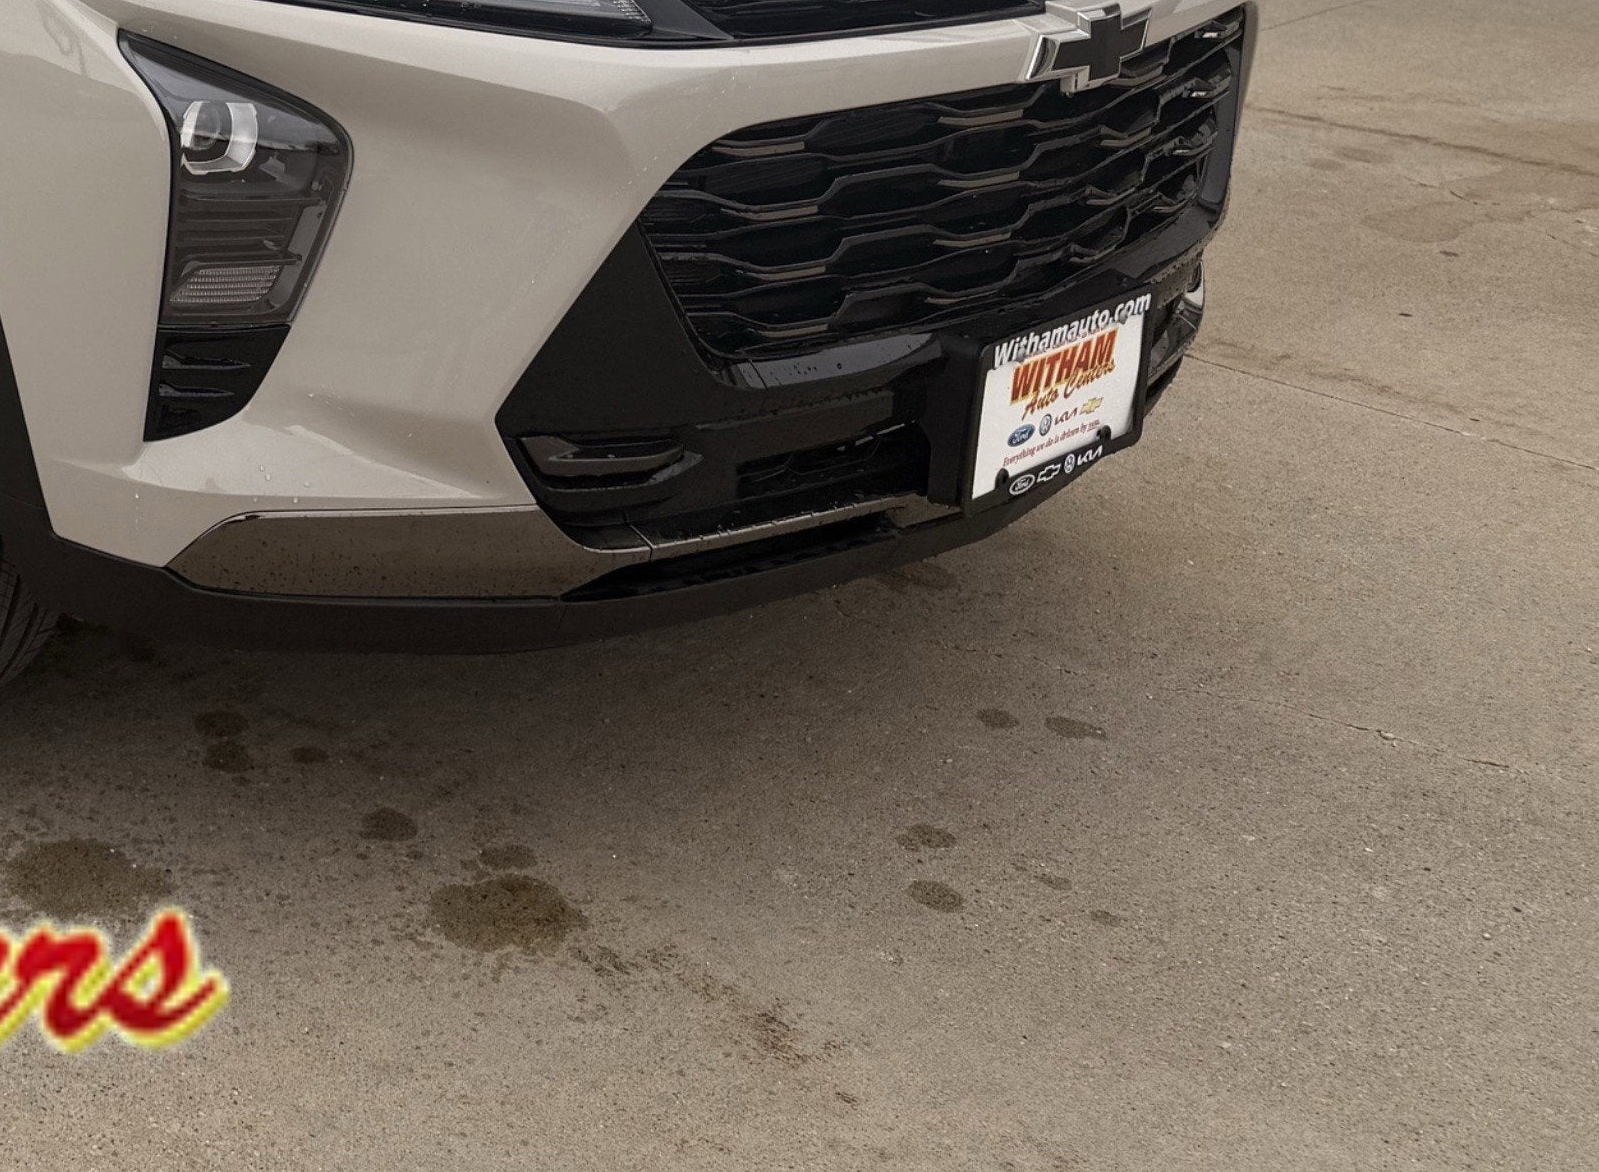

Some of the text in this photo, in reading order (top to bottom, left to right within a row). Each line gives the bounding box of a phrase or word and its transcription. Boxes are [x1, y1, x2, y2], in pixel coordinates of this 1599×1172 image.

[1010, 328, 1118, 404] WITHAM
[1021, 358, 1115, 421] Auto Centers
